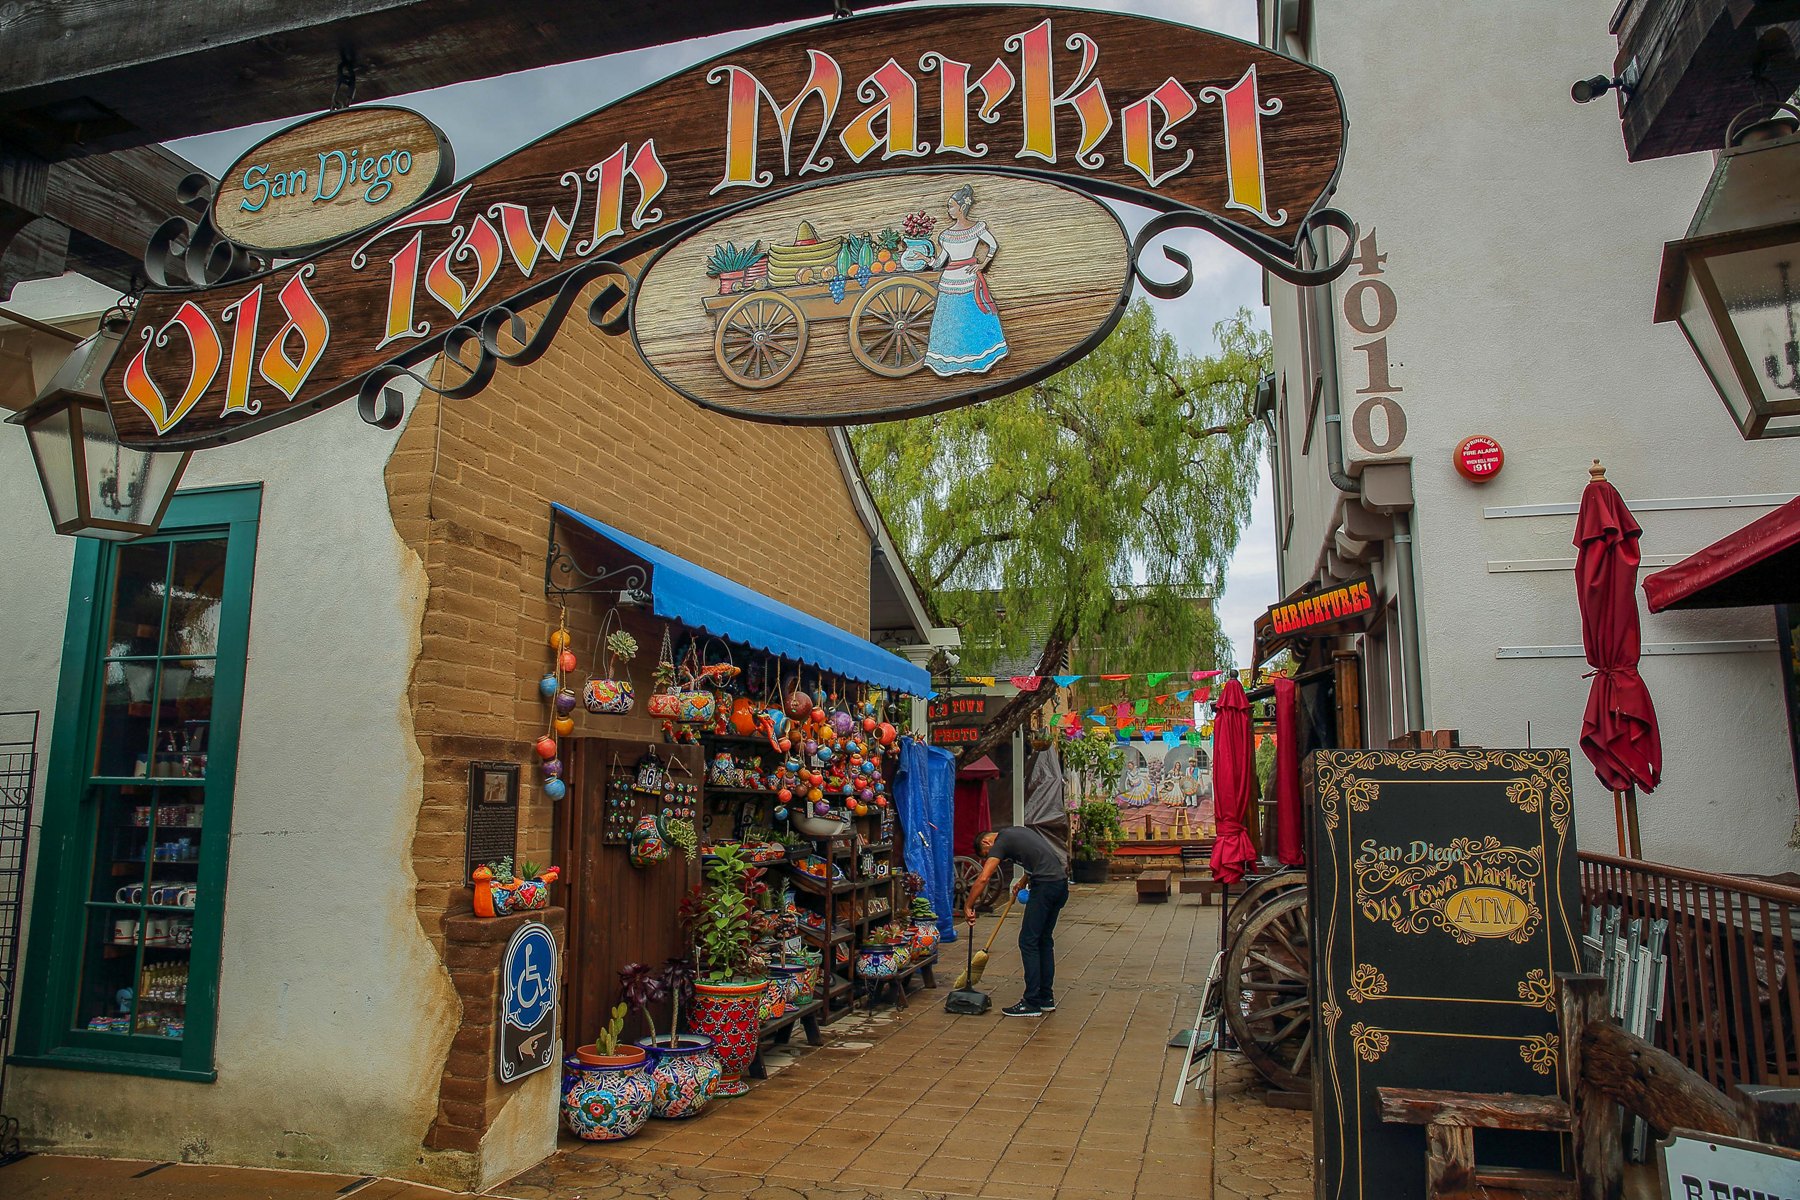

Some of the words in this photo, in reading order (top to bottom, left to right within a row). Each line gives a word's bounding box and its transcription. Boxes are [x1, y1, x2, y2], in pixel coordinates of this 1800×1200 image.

[239, 163, 308, 213] San
[312, 149, 413, 204] Diego
[123, 264, 331, 436] Old
[351, 138, 669, 351] Town
[706, 18, 1288, 228] Market
[1343, 223, 1408, 455] 4010
[1464, 438, 1495, 450] SPRINKLER
[1476, 463, 1492, 471] 911
[1271, 581, 1372, 635] CARICATURES
[928, 703, 948, 718] OD
[952, 699, 984, 713] TOWN
[934, 727, 978, 742] PHOTO
[1360, 838, 1402, 864] San
[1404, 840, 1464, 871] Diego
[1362, 895, 1402, 922] Old
[1402, 874, 1458, 912] Town
[1460, 860, 1536, 905] Market
[1454, 896, 1518, 925] ATM
